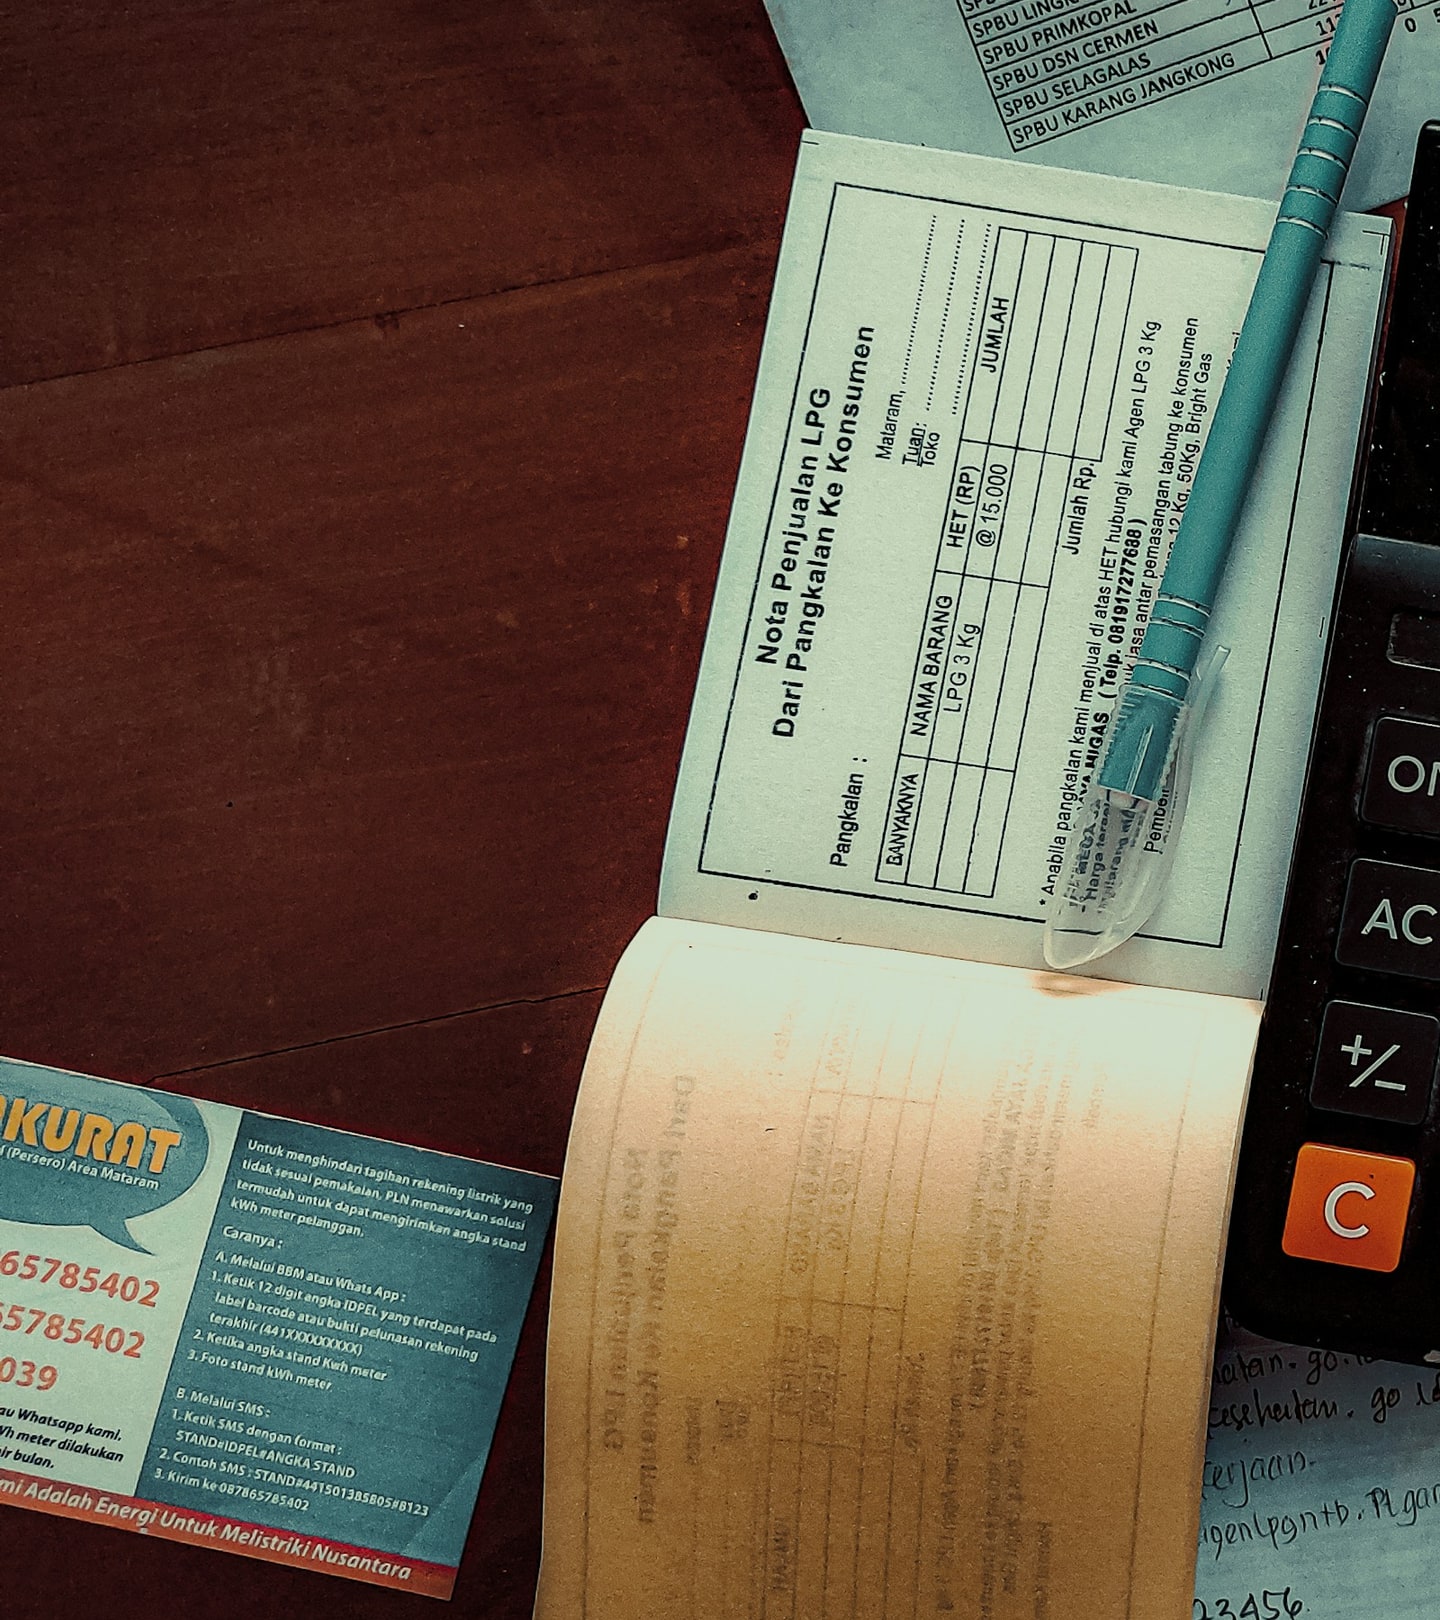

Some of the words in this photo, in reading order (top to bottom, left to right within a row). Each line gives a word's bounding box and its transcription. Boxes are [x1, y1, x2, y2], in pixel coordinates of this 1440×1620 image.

[973, 11, 1019, 38] SPBU
[983, 37, 1029, 65] SPBU
[1033, 2, 1137, 45] PRIMKOPAL
[1404, 17, 1417, 33] 0
[992, 62, 1039, 91] SPBU
[1043, 48, 1080, 73] DSN
[1082, 19, 1159, 59] CERMEN
[1003, 88, 1049, 117] SPBU
[1054, 52, 1151, 100] SELAGALAS
[1013, 115, 1058, 144] SPBU
[1062, 88, 1137, 126] KARANG
[1140, 52, 1236, 99] JANGKONG
[980, 297, 1009, 373] JUMLAH
[1138, 346, 1153, 355] 3
[1140, 321, 1162, 341] Kg
[1131, 360, 1150, 393] LPG
[1170, 318, 1198, 396] konsumen
[1194, 353, 1212, 383] Gas
[801, 389, 830, 446] LPG
[826, 327, 874, 473] Konsumen
[1124, 399, 1145, 439] Agen
[1167, 400, 1184, 418] ke
[1185, 388, 1207, 434] Bright
[875, 390, 906, 460] Mataram,
[919, 432, 940, 467] Toko
[1115, 441, 1137, 478] kami
[1158, 423, 1184, 475] tabung
[1176, 440, 1200, 485] 50Kg,
[955, 466, 981, 505] (RP)
[980, 464, 1008, 523] 15.000
[1072, 463, 1097, 490] Rp.
[817, 483, 843, 517] Ke
[1104, 481, 1132, 543] hubungi
[771, 456, 818, 591] Penjualan
[946, 509, 968, 548] HET
[975, 529, 996, 547] @
[1061, 496, 1089, 555] Jumlah
[1143, 480, 1171, 579] pemasangan
[1098, 546, 1118, 581] HET
[785, 527, 835, 671] Pangkalan
[1094, 586, 1111, 619] atas
[1135, 582, 1153, 623] antar
[755, 601, 789, 664] Nota
[922, 596, 953, 676] BARANG
[956, 624, 981, 648] Kg
[1089, 622, 1105, 637] di
[953, 655, 970, 665] 3
[1079, 641, 1102, 703] menjual
[1099, 649, 1123, 687] Telp.
[772, 680, 803, 737] Dari
[910, 681, 937, 736] NAMA
[943, 672, 967, 712] LPG
[1068, 707, 1090, 744] kami
[1057, 749, 1088, 831] pangkalan
[829, 774, 864, 867] Pangkalan
[886, 774, 919, 866] BANYAKNYA
[1361, 898, 1438, 946] AC
[248, 1139, 284, 1157] Untuk
[7, 1147, 66, 1171] (Persero)
[67, 1160, 98, 1177] Area
[100, 1167, 159, 1190] Mataram
[260, 1206, 297, 1221] meter
[385, 1191, 410, 1205] PLN
[1324, 1181, 1376, 1240] C
[223, 1226, 275, 1247] Caranya
[297, 1195, 333, 1209] untuk
[452, 1229, 490, 1243] angka
[492, 1237, 526, 1251] stand
[276, 1264, 304, 1279] BBM
[374, 1286, 399, 1303] App
[247, 1299, 296, 1320] barcode
[297, 1313, 326, 1326] atau
[343, 1299, 378, 1317] IDPEL
[380, 1310, 411, 1326] yang
[286, 1351, 321, 1366] stand
[295, 1376, 332, 1392] meter
[18, 1408, 84, 1435] Whatsapp
[217, 1419, 244, 1433] SMS
[246, 1424, 292, 1444] dengan
[13, 1449, 54, 1468] bulan.
[16, 1432, 57, 1447] meter
[58, 1439, 124, 1462] dilakukan
[173, 1451, 217, 1470] Contoh
[219, 1461, 246, 1476] SMS
[167, 1470, 200, 1487] Kirim
[312, 1460, 355, 1478] STAND
[23, 1482, 92, 1510] Adalah
[94, 1497, 158, 1527] Energi
[160, 1510, 218, 1537] Untuk
[219, 1524, 311, 1557] Melistriki
[311, 1544, 411, 1579] Nusantara
